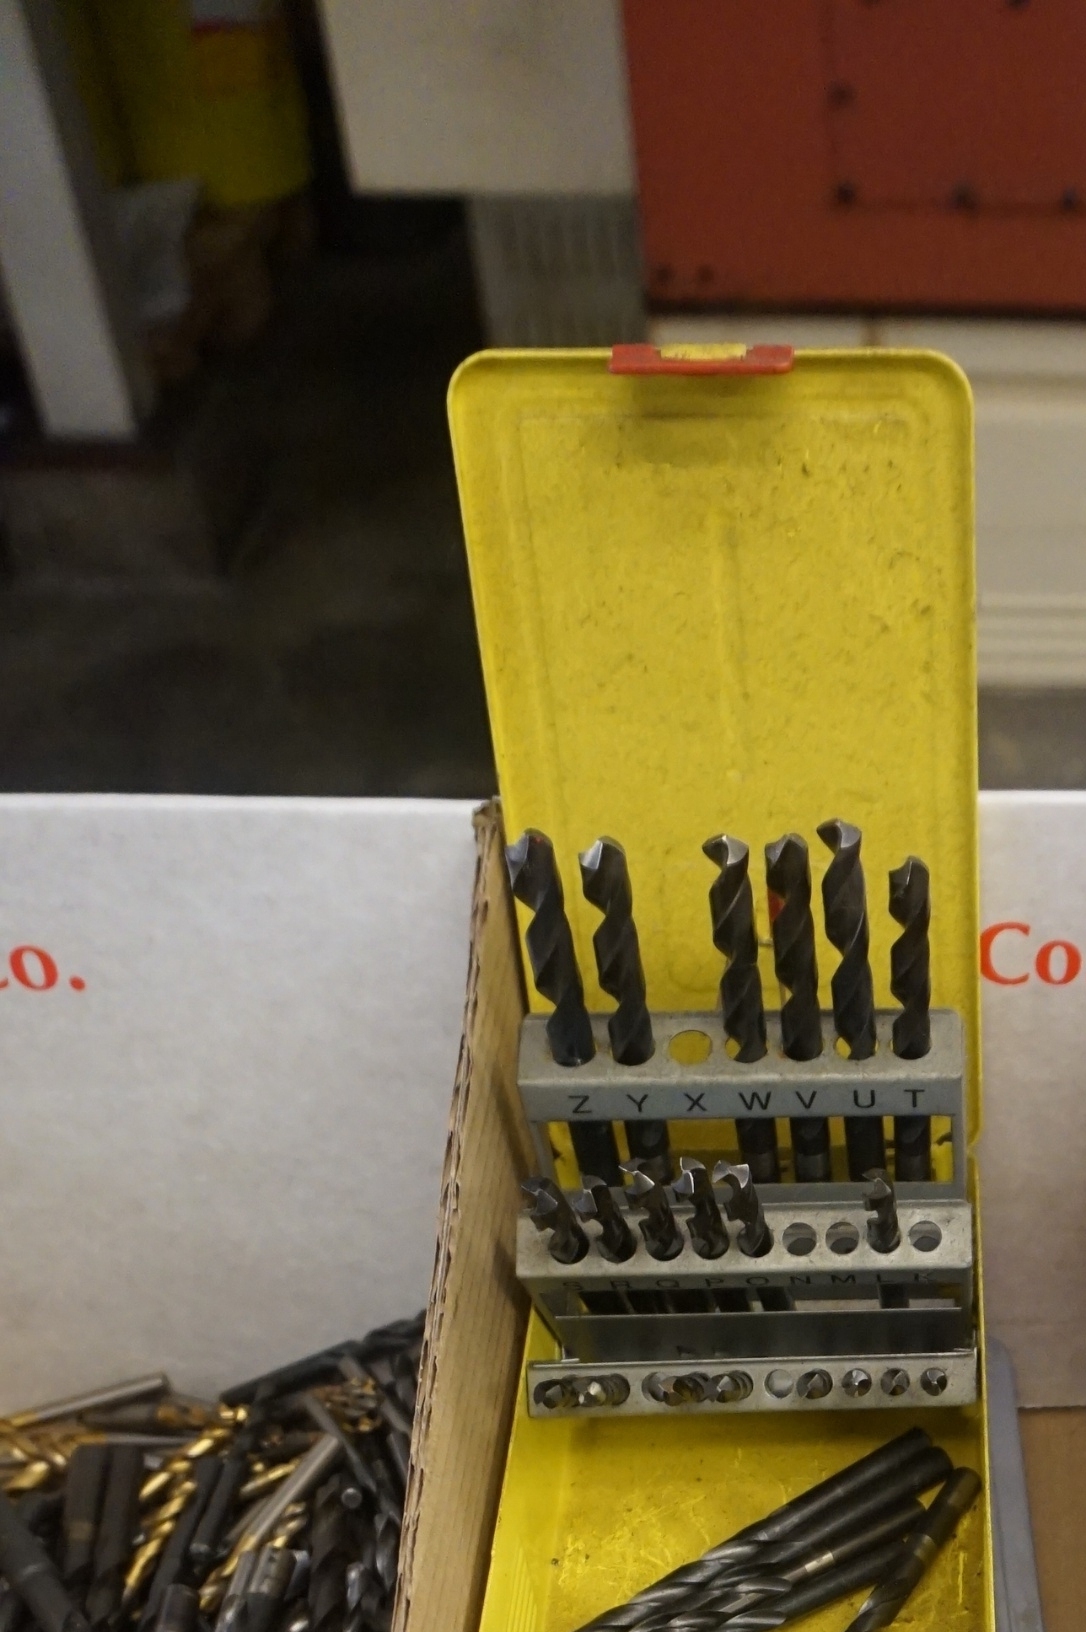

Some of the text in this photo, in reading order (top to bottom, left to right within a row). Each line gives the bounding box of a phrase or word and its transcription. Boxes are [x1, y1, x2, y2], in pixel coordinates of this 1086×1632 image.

[0, 945, 86, 991] o.
[568, 1089, 925, 1114] Z Y X W V U T
[704, 1278, 725, 1288] P
[789, 1275, 812, 1285] N
[830, 1274, 857, 1284] M
[877, 1273, 894, 1283] L
[914, 1272, 936, 1282] K
